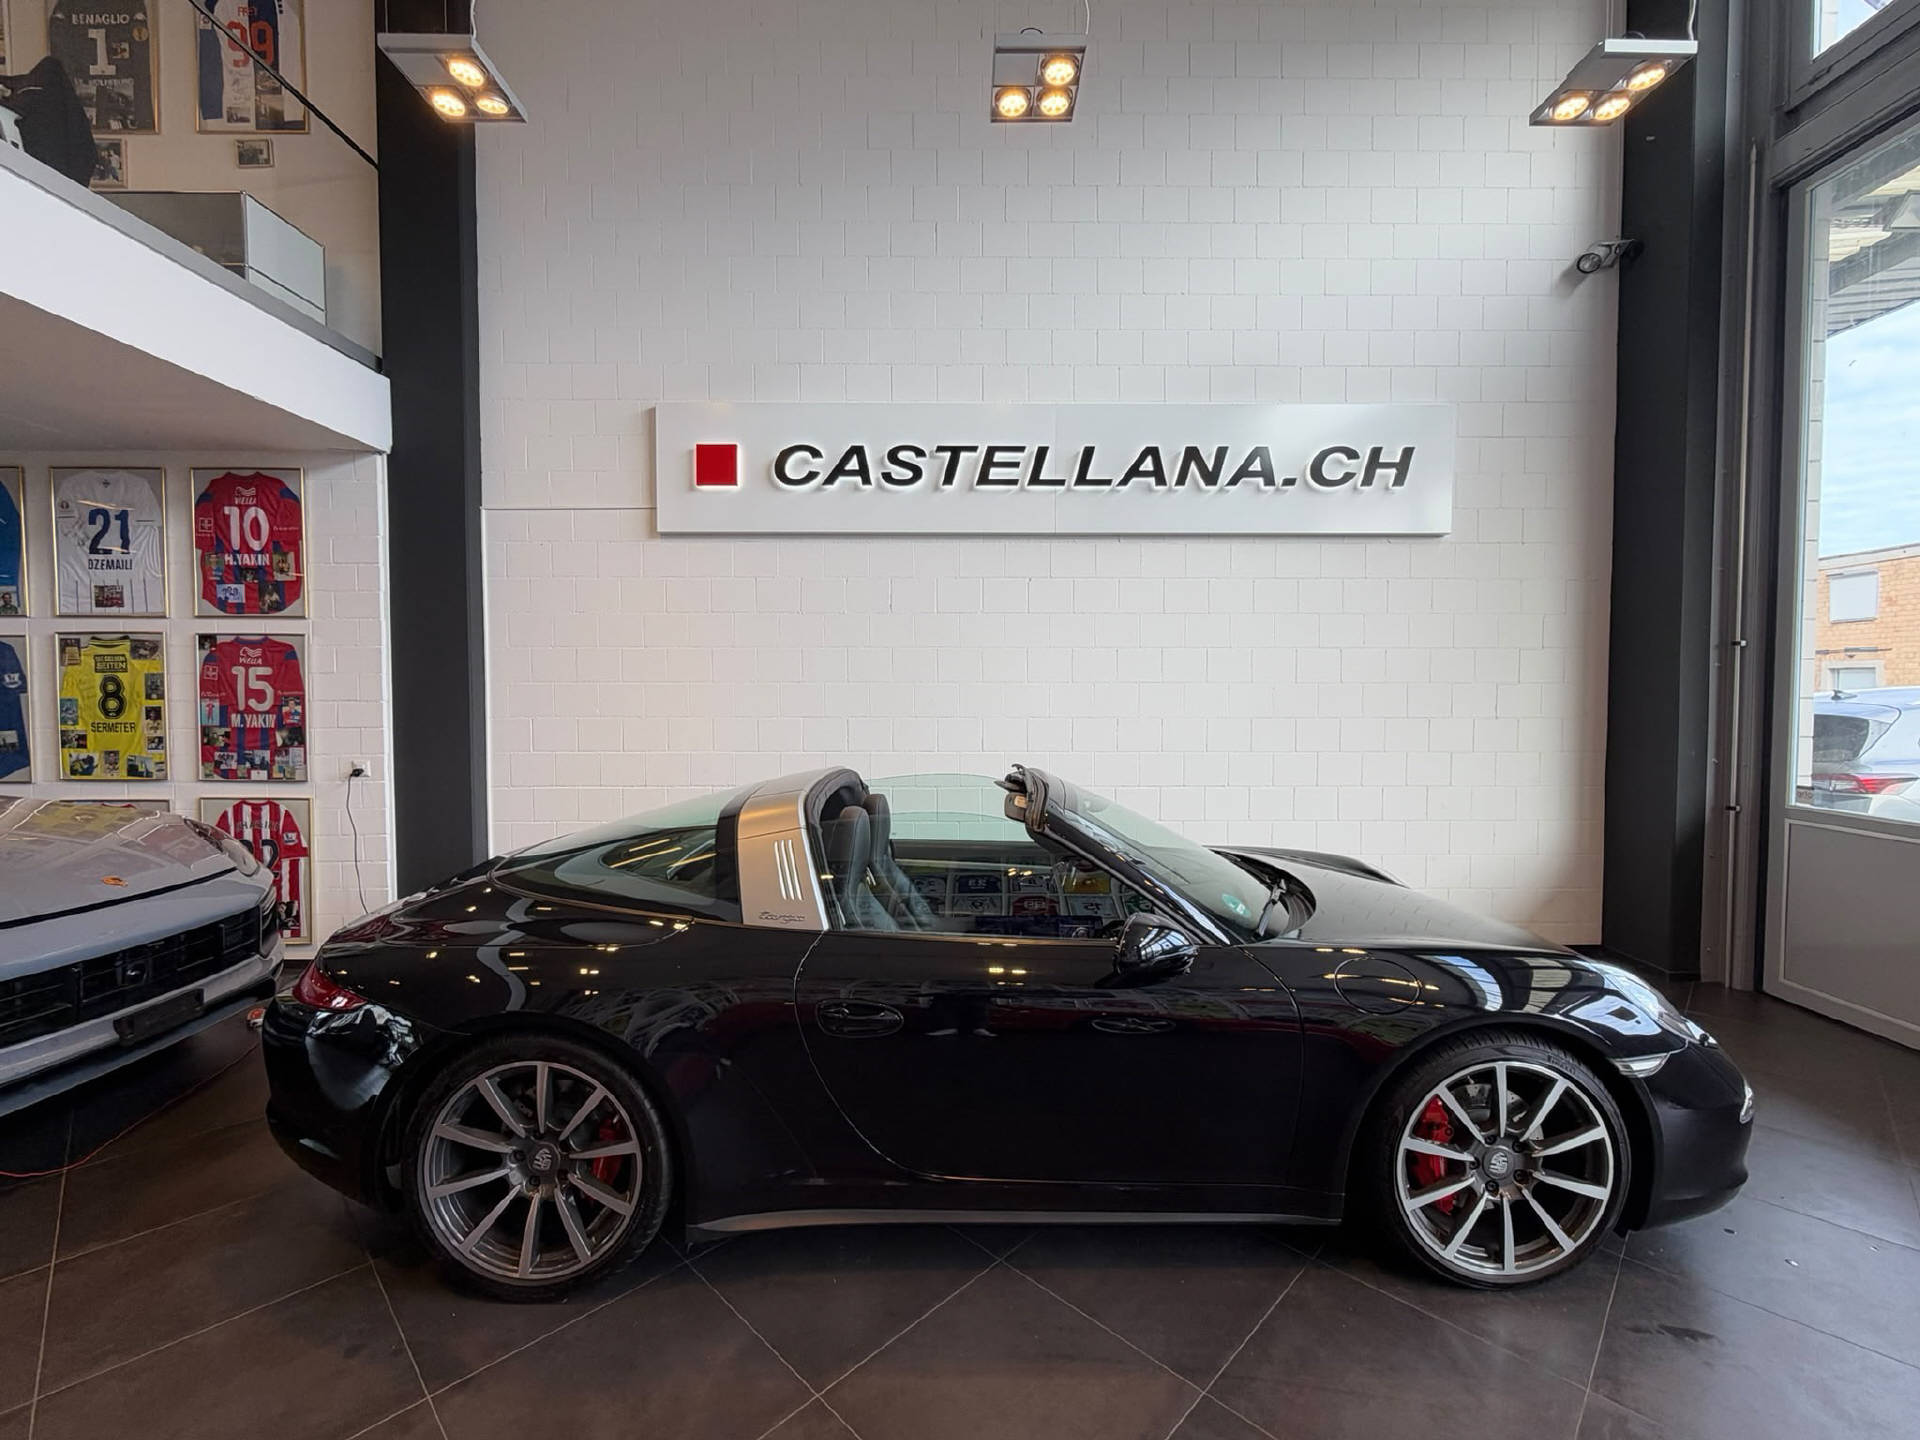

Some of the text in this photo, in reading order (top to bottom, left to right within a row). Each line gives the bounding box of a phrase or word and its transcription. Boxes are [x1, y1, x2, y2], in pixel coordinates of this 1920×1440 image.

[72, 13, 130, 25] BENAGLIO
[88, 28, 117, 76] 1
[225, 20, 274, 68] 99
[773, 443, 1416, 488] CASTELLANA.CH
[88, 508, 131, 555] 21
[223, 505, 270, 551] 10
[88, 558, 133, 571] DZEMAILI
[98, 673, 128, 719] 8
[231, 665, 275, 712] 15
[90, 721, 136, 734] SERMETER
